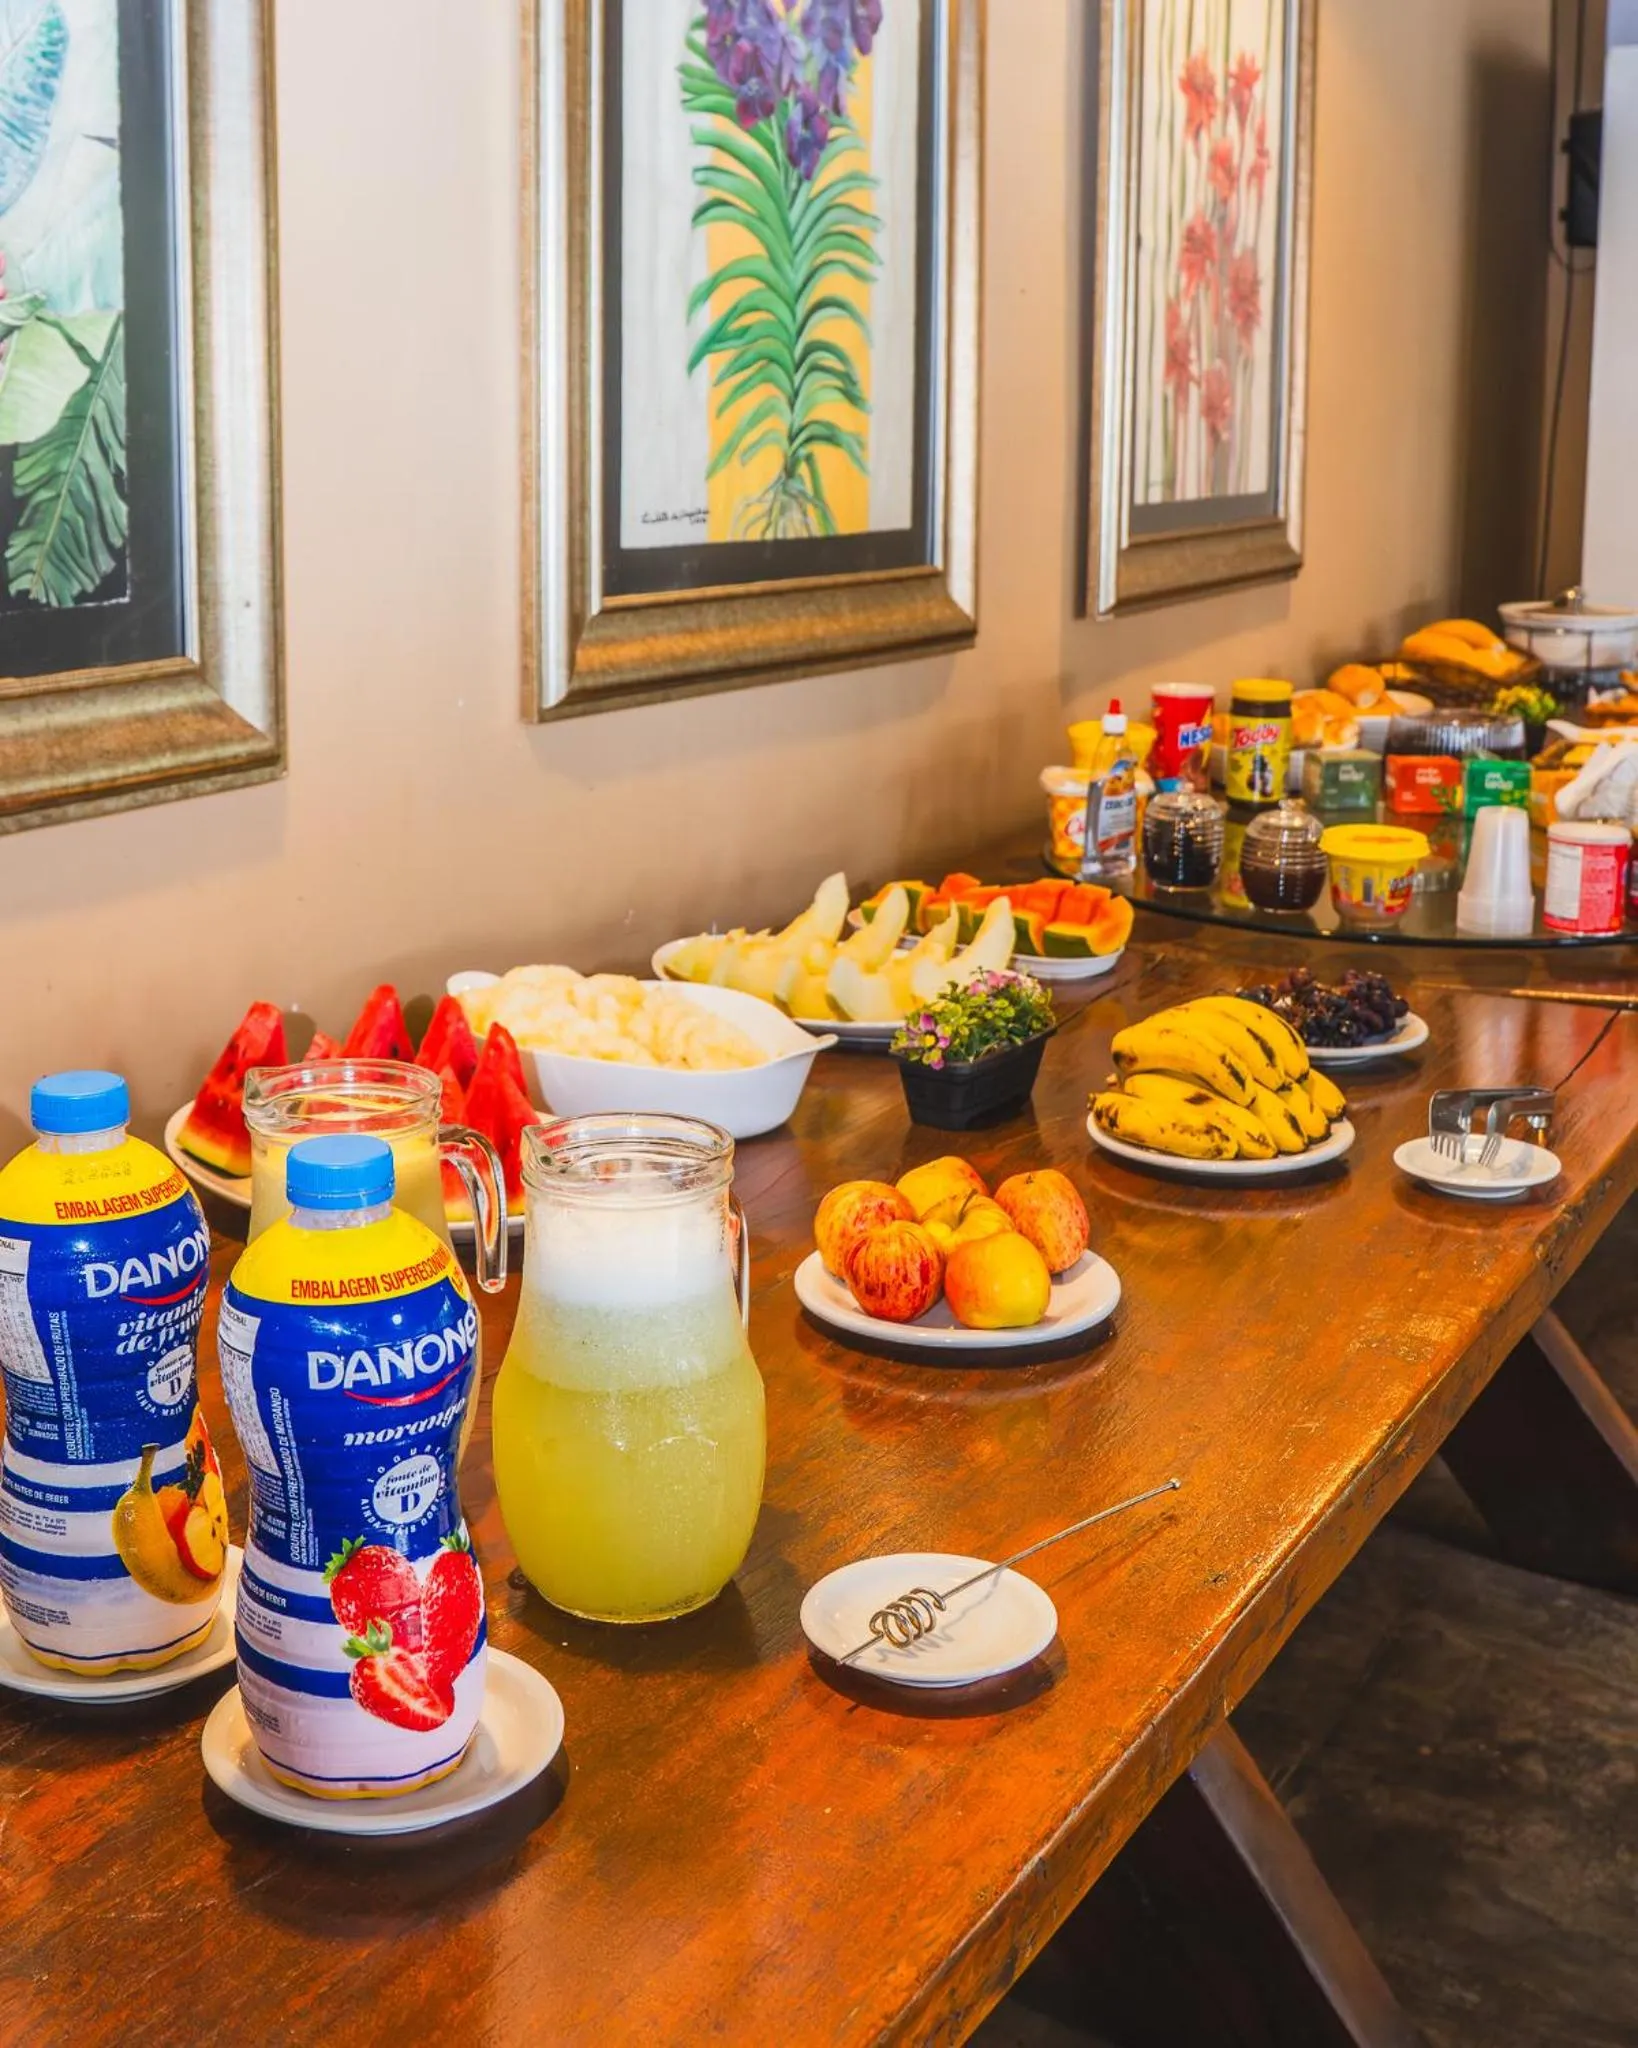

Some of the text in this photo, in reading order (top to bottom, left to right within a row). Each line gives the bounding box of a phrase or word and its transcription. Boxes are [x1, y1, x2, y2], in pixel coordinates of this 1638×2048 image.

[54, 1194, 142, 1221] EMBALAGEM
[291, 1276, 379, 1299] EMBALAGEM
[49, 1312, 62, 1344] FRUTAS
[54, 1344, 64, 1356] DE
[115, 1333, 152, 1356] de
[307, 1308, 478, 1390] DANONE
[56, 1356, 70, 1402] PREPARADO
[169, 1376, 182, 1397] D
[61, 1402, 73, 1421] COM
[269, 1387, 284, 1434] MORANGO
[343, 1397, 466, 1446] morango
[63, 1422, 77, 1460] IOGURTE
[277, 1435, 288, 1447] DE
[279, 1447, 298, 1498] PREPARADO
[384, 1464, 432, 1487] fonte de
[45, 1492, 70, 1504] BEBER
[375, 1473, 438, 1499] vitamina
[288, 1499, 299, 1520] COM
[400, 1491, 421, 1513] D
[289, 1520, 301, 1562] IOGURTE
